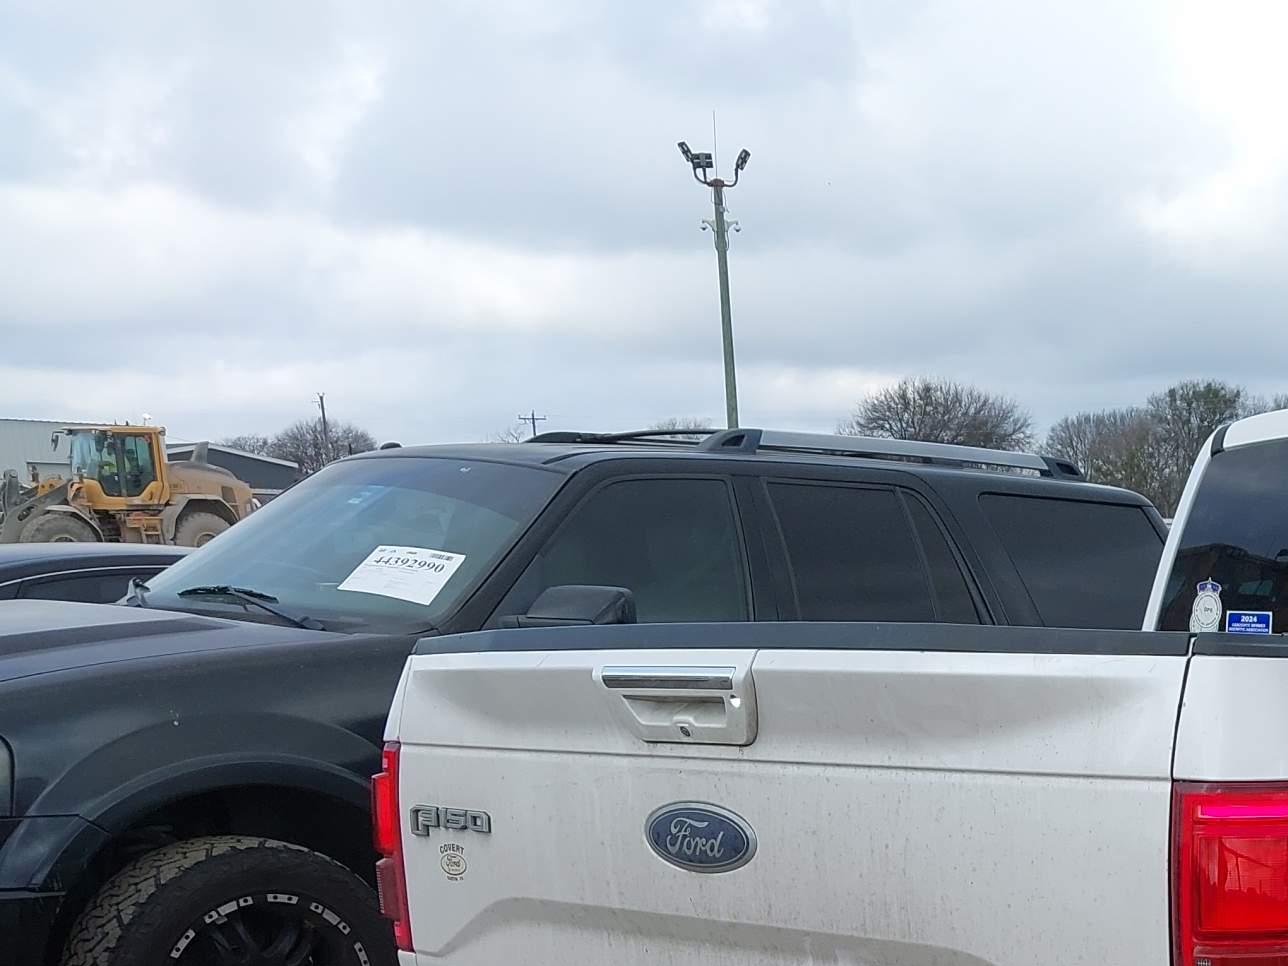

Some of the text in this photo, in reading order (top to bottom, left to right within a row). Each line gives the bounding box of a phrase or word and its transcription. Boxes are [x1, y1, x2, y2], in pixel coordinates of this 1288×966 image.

[373, 556, 445, 573] 44392990
[1240, 615, 1258, 623] 2024
[666, 817, 725, 858] Ford
[439, 843, 465, 855] COVERT
